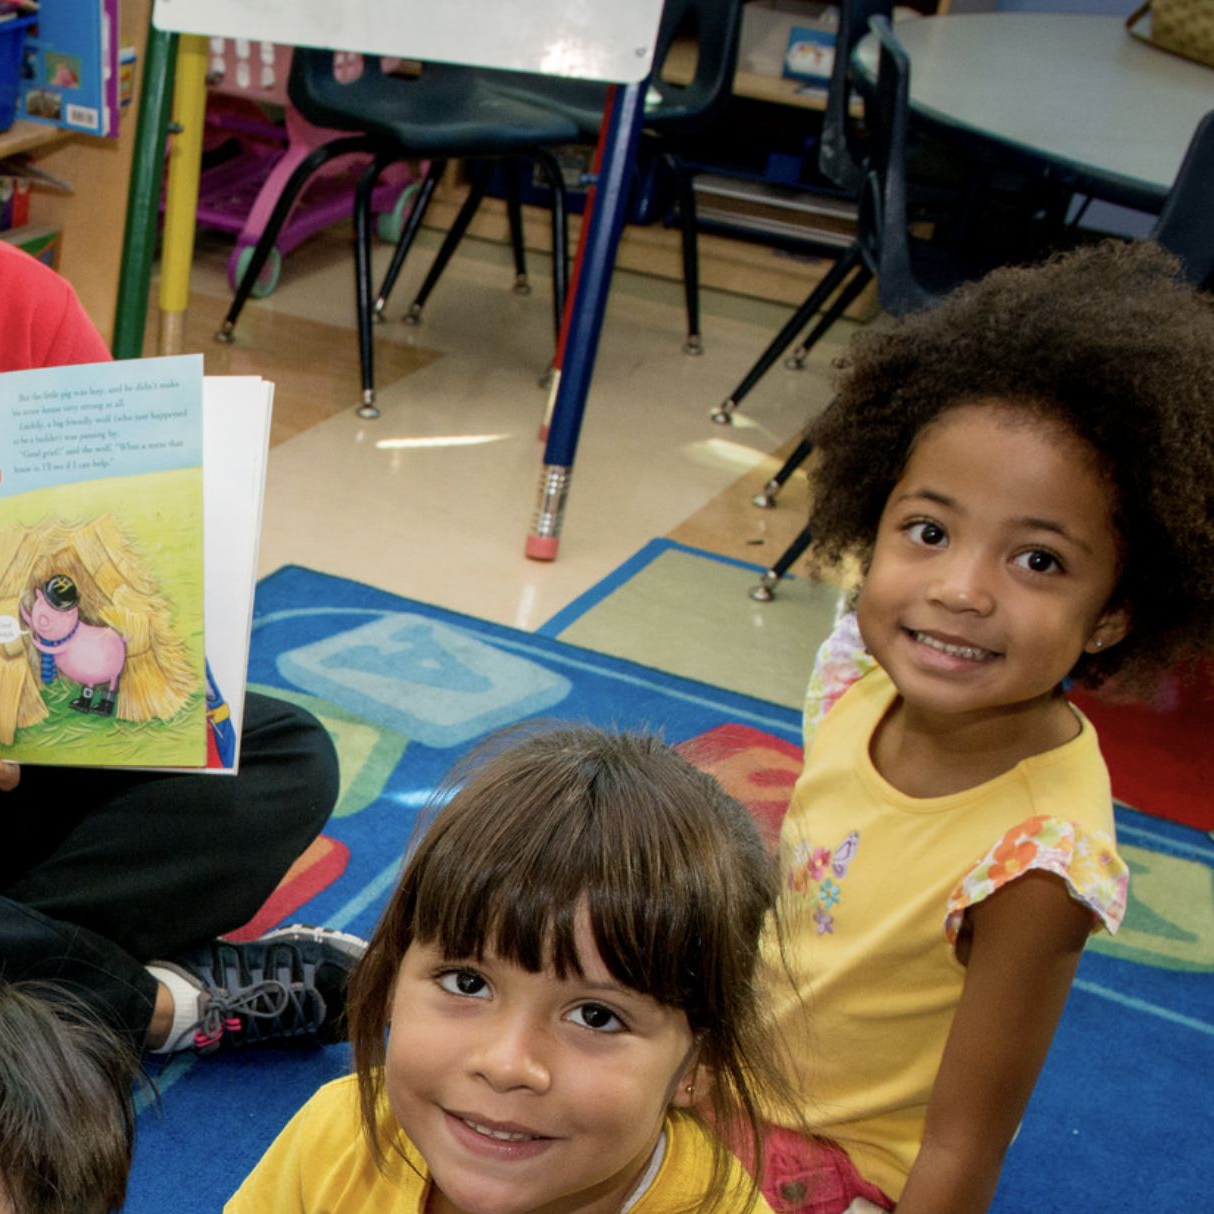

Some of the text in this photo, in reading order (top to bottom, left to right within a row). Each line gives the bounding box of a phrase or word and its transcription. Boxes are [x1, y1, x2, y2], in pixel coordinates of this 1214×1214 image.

[43, 389, 59, 400] little
[60, 389, 72, 400] pig
[108, 385, 122, 395] and
[159, 380, 180, 390] make
[53, 417, 64, 429] big
[150, 408, 187, 421] happened
[64, 433, 78, 441] was
